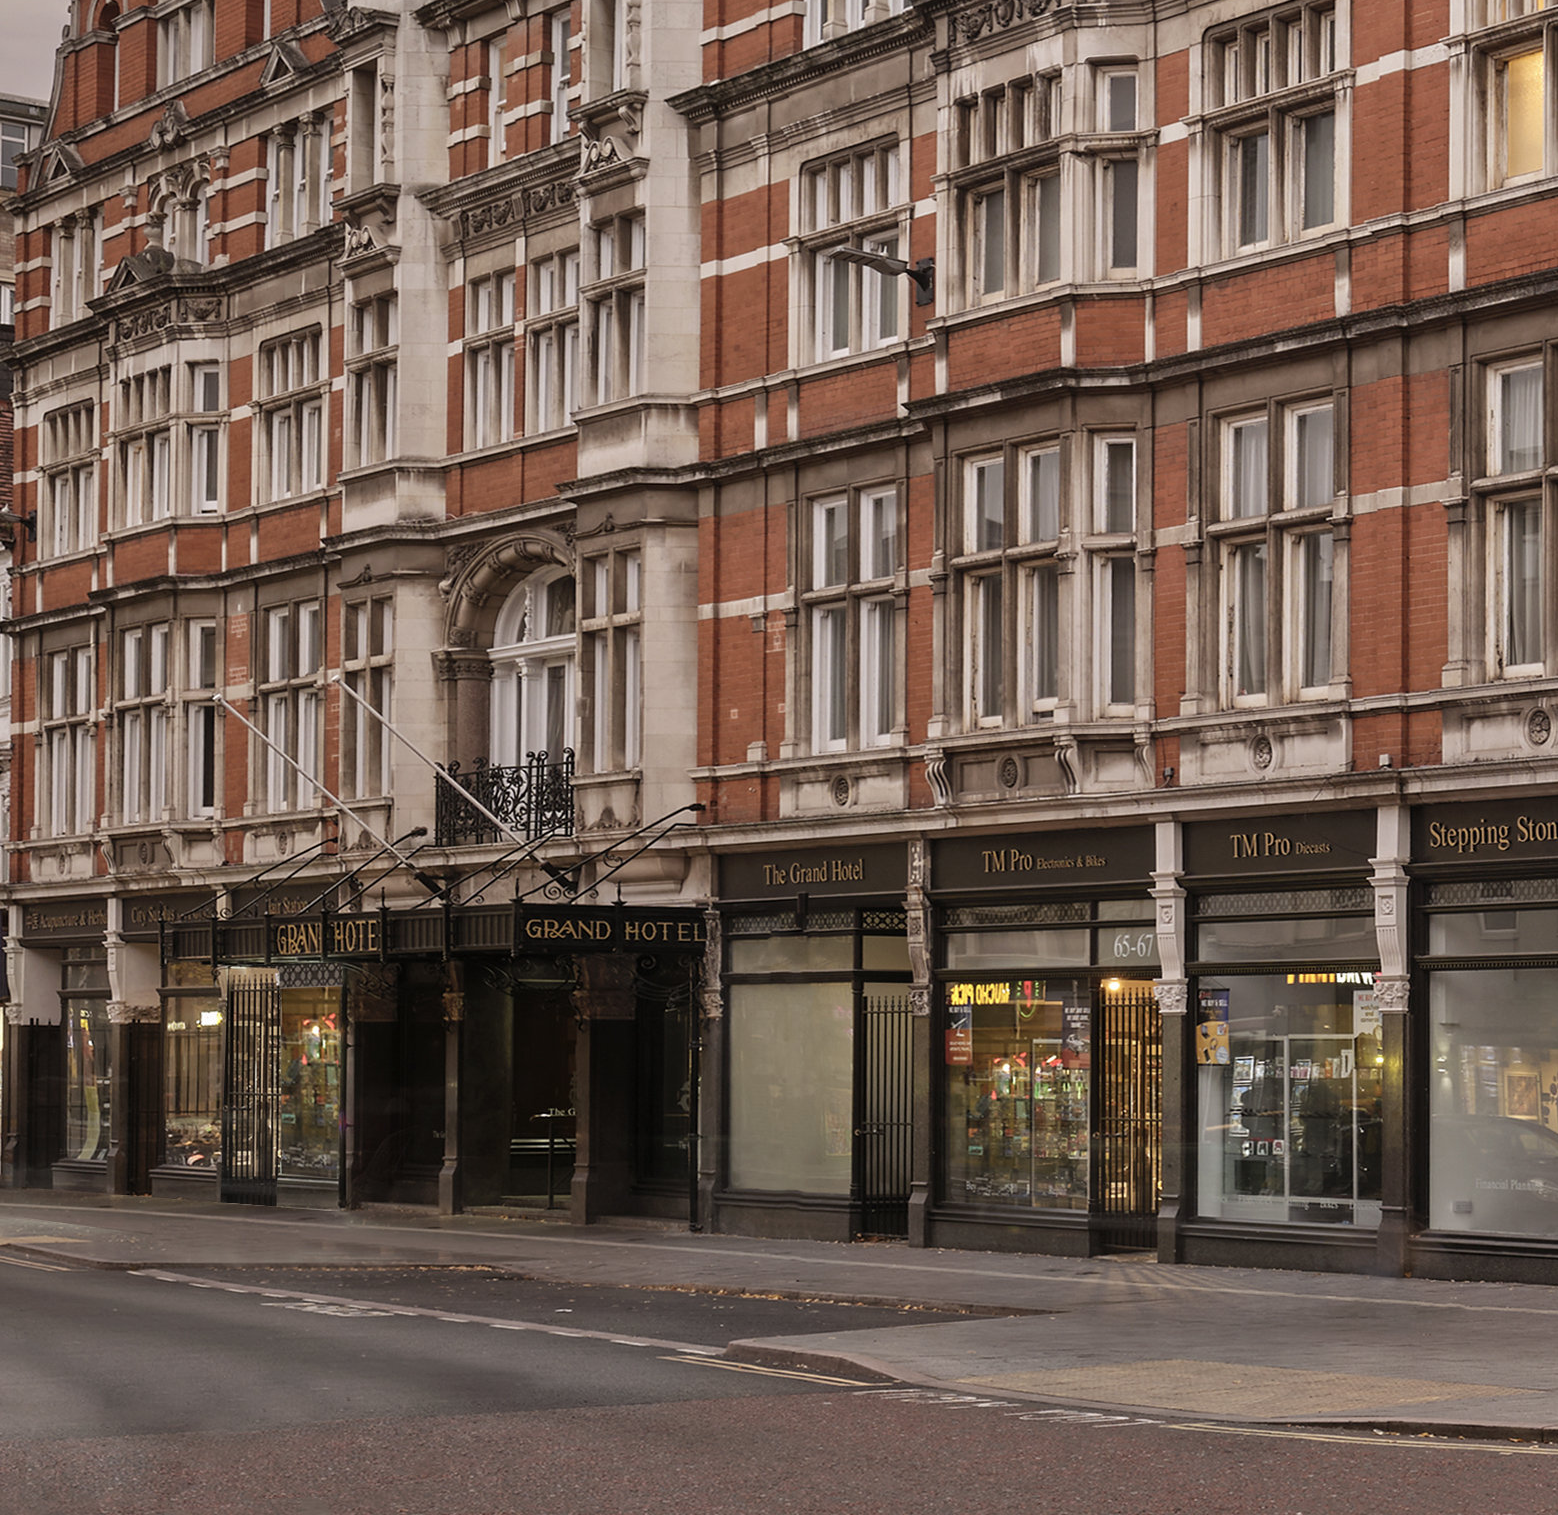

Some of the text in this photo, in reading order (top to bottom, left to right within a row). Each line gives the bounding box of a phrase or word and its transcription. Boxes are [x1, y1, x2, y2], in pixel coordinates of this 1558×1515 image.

[1230, 832, 1331, 858] TM Pro Diecasts
[1430, 819, 1509, 852] Stepping
[764, 859, 863, 885] The Grand Hotel
[982, 850, 1005, 873] TM
[1011, 849, 1033, 872] Pro
[1076, 856, 1083, 867] &
[334, 920, 378, 952] HOTE
[525, 919, 706, 942] GRAND HOTEL
[1114, 934, 1154, 958] 65-67
